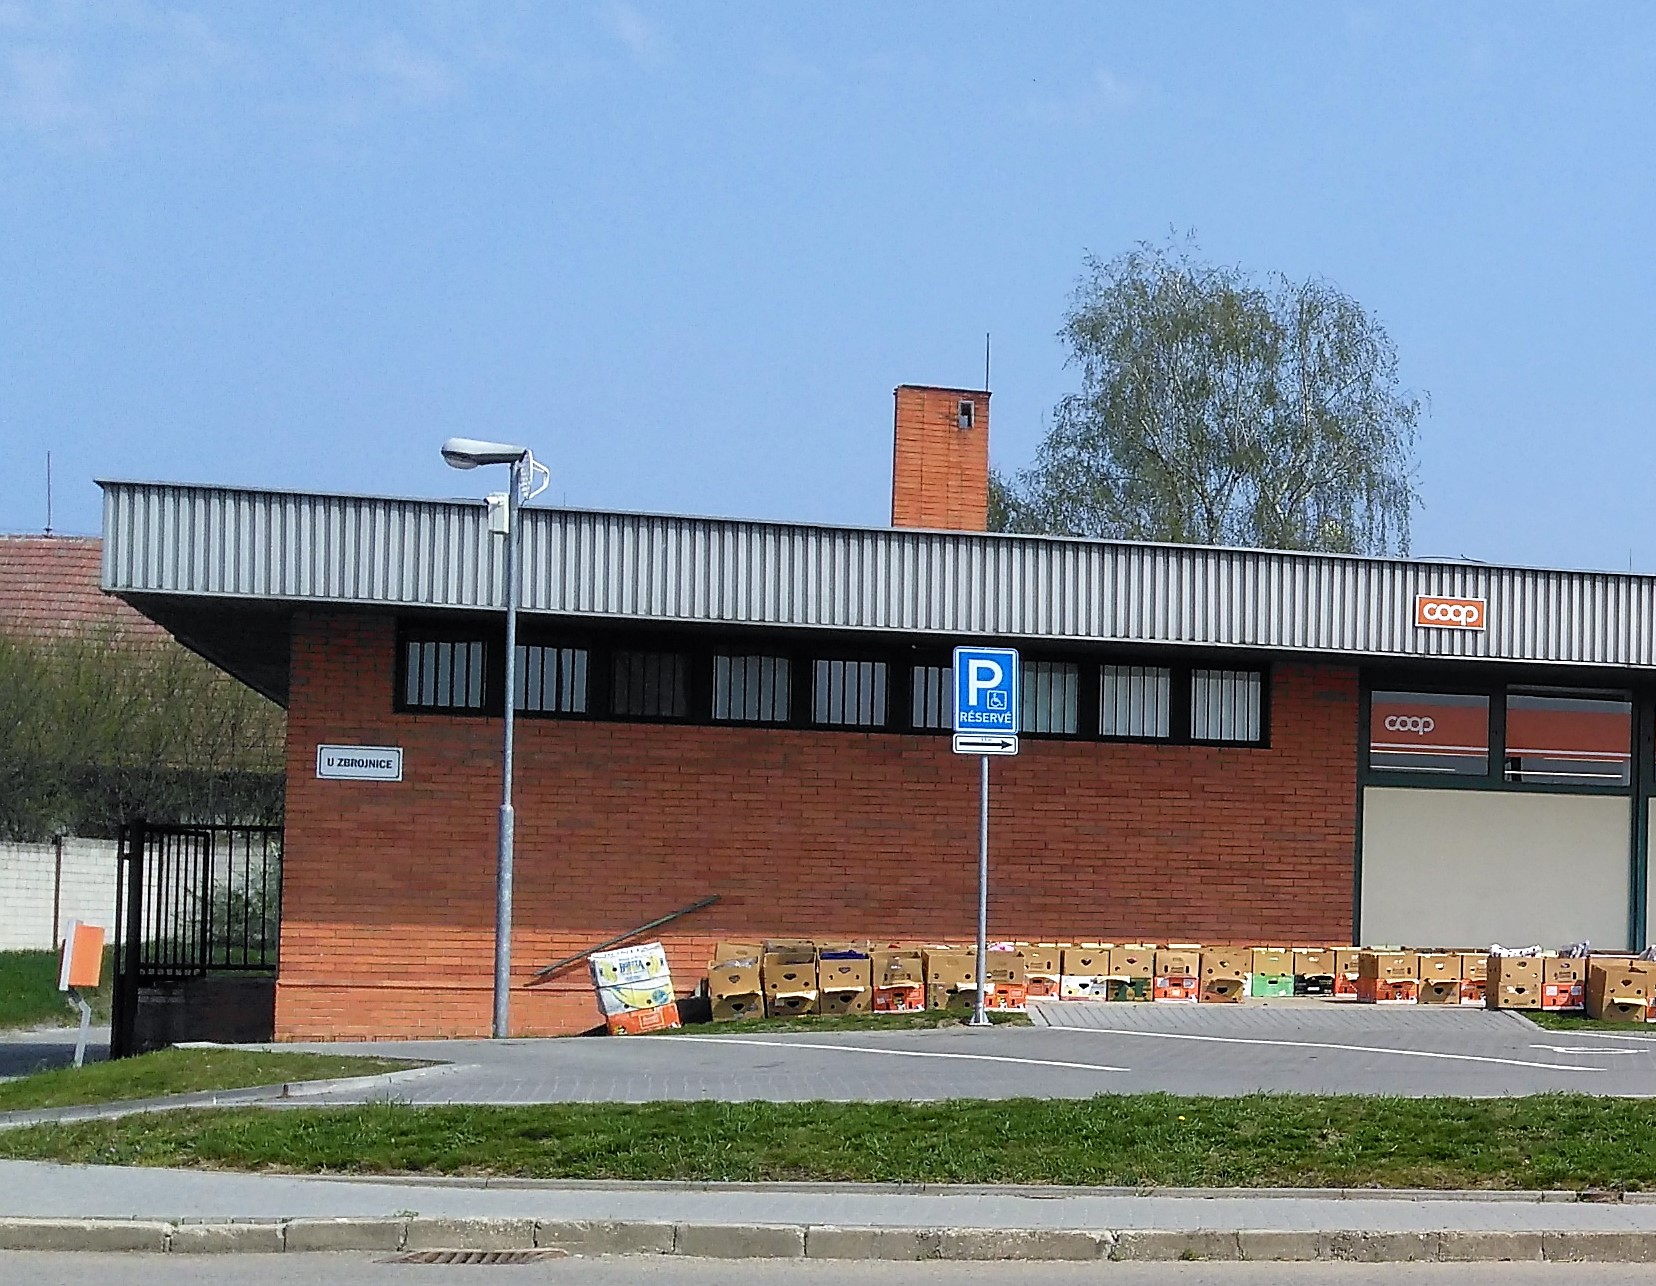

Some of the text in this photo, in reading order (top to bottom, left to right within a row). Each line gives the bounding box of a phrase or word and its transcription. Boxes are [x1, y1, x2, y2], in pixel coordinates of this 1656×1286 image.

[1423, 603, 1479, 626] coop
[968, 659, 1003, 706] P
[960, 710, 1012, 724] RÉSERVÉ
[1385, 715, 1435, 735] coop
[327, 757, 393, 769] U ZBROJNICE
